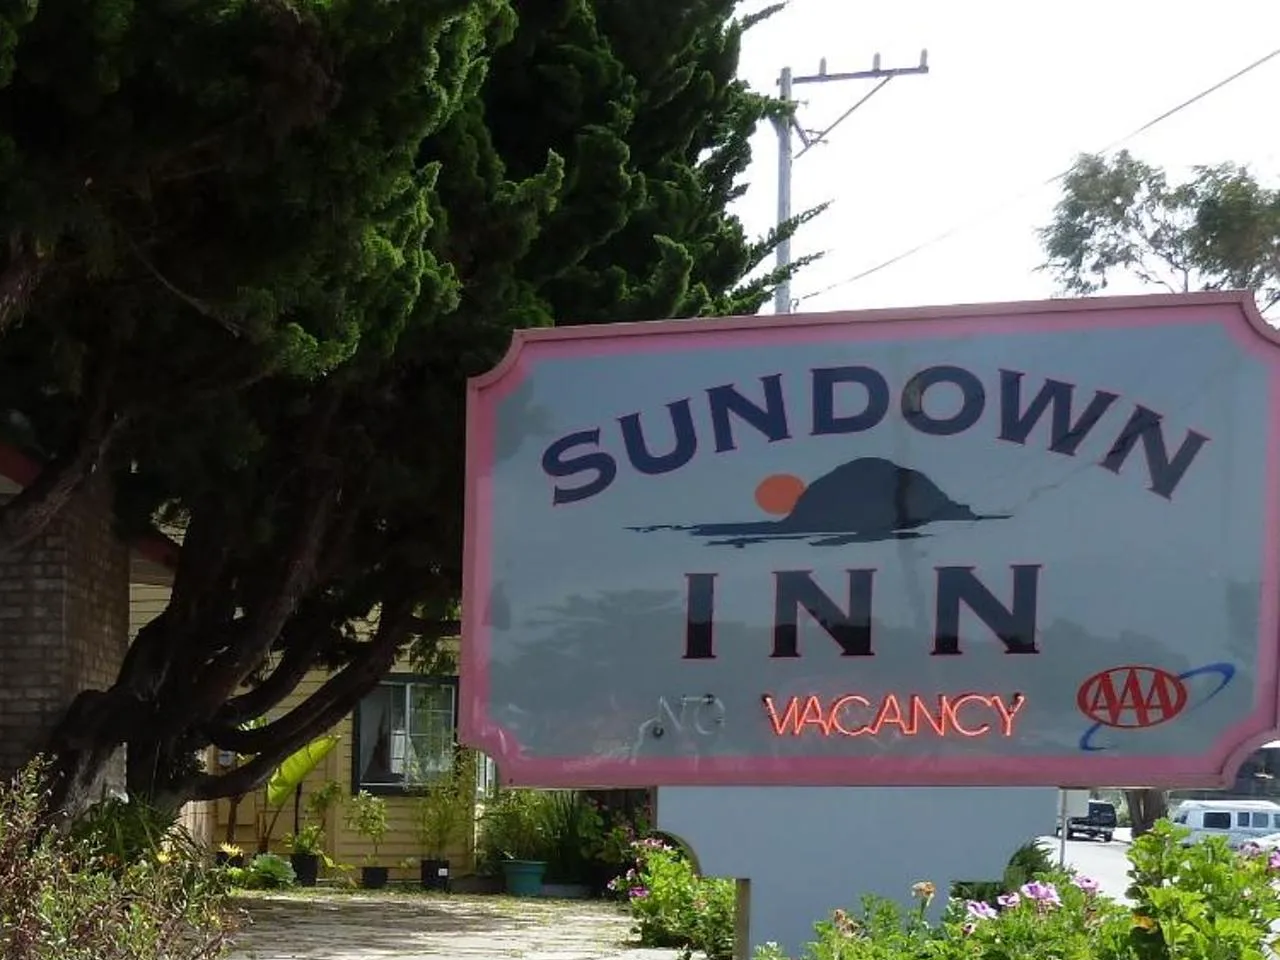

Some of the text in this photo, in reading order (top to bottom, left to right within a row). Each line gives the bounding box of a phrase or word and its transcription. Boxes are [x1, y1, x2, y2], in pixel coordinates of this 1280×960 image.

[541, 365, 1212, 507] SUNDOWN
[682, 563, 1043, 660] INN
[763, 693, 1025, 738] VACANCY
[1086, 667, 1179, 727] AAA
